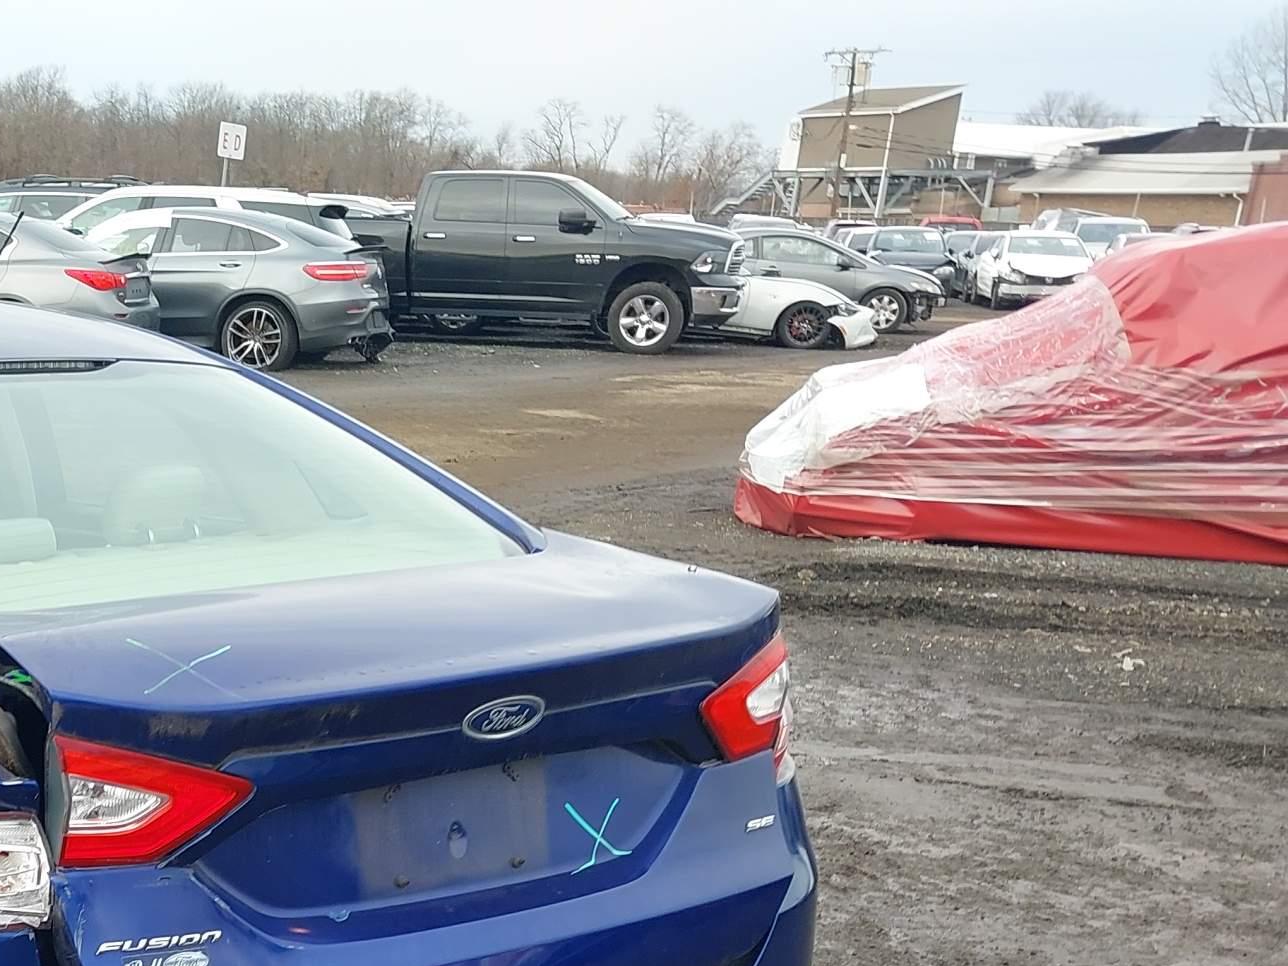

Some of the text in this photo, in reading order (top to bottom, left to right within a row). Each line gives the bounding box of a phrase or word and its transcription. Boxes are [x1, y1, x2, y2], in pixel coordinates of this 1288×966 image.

[233, 134, 242, 151] D
[481, 704, 530, 732] Ford
[95, 929, 222, 956] FUSION
